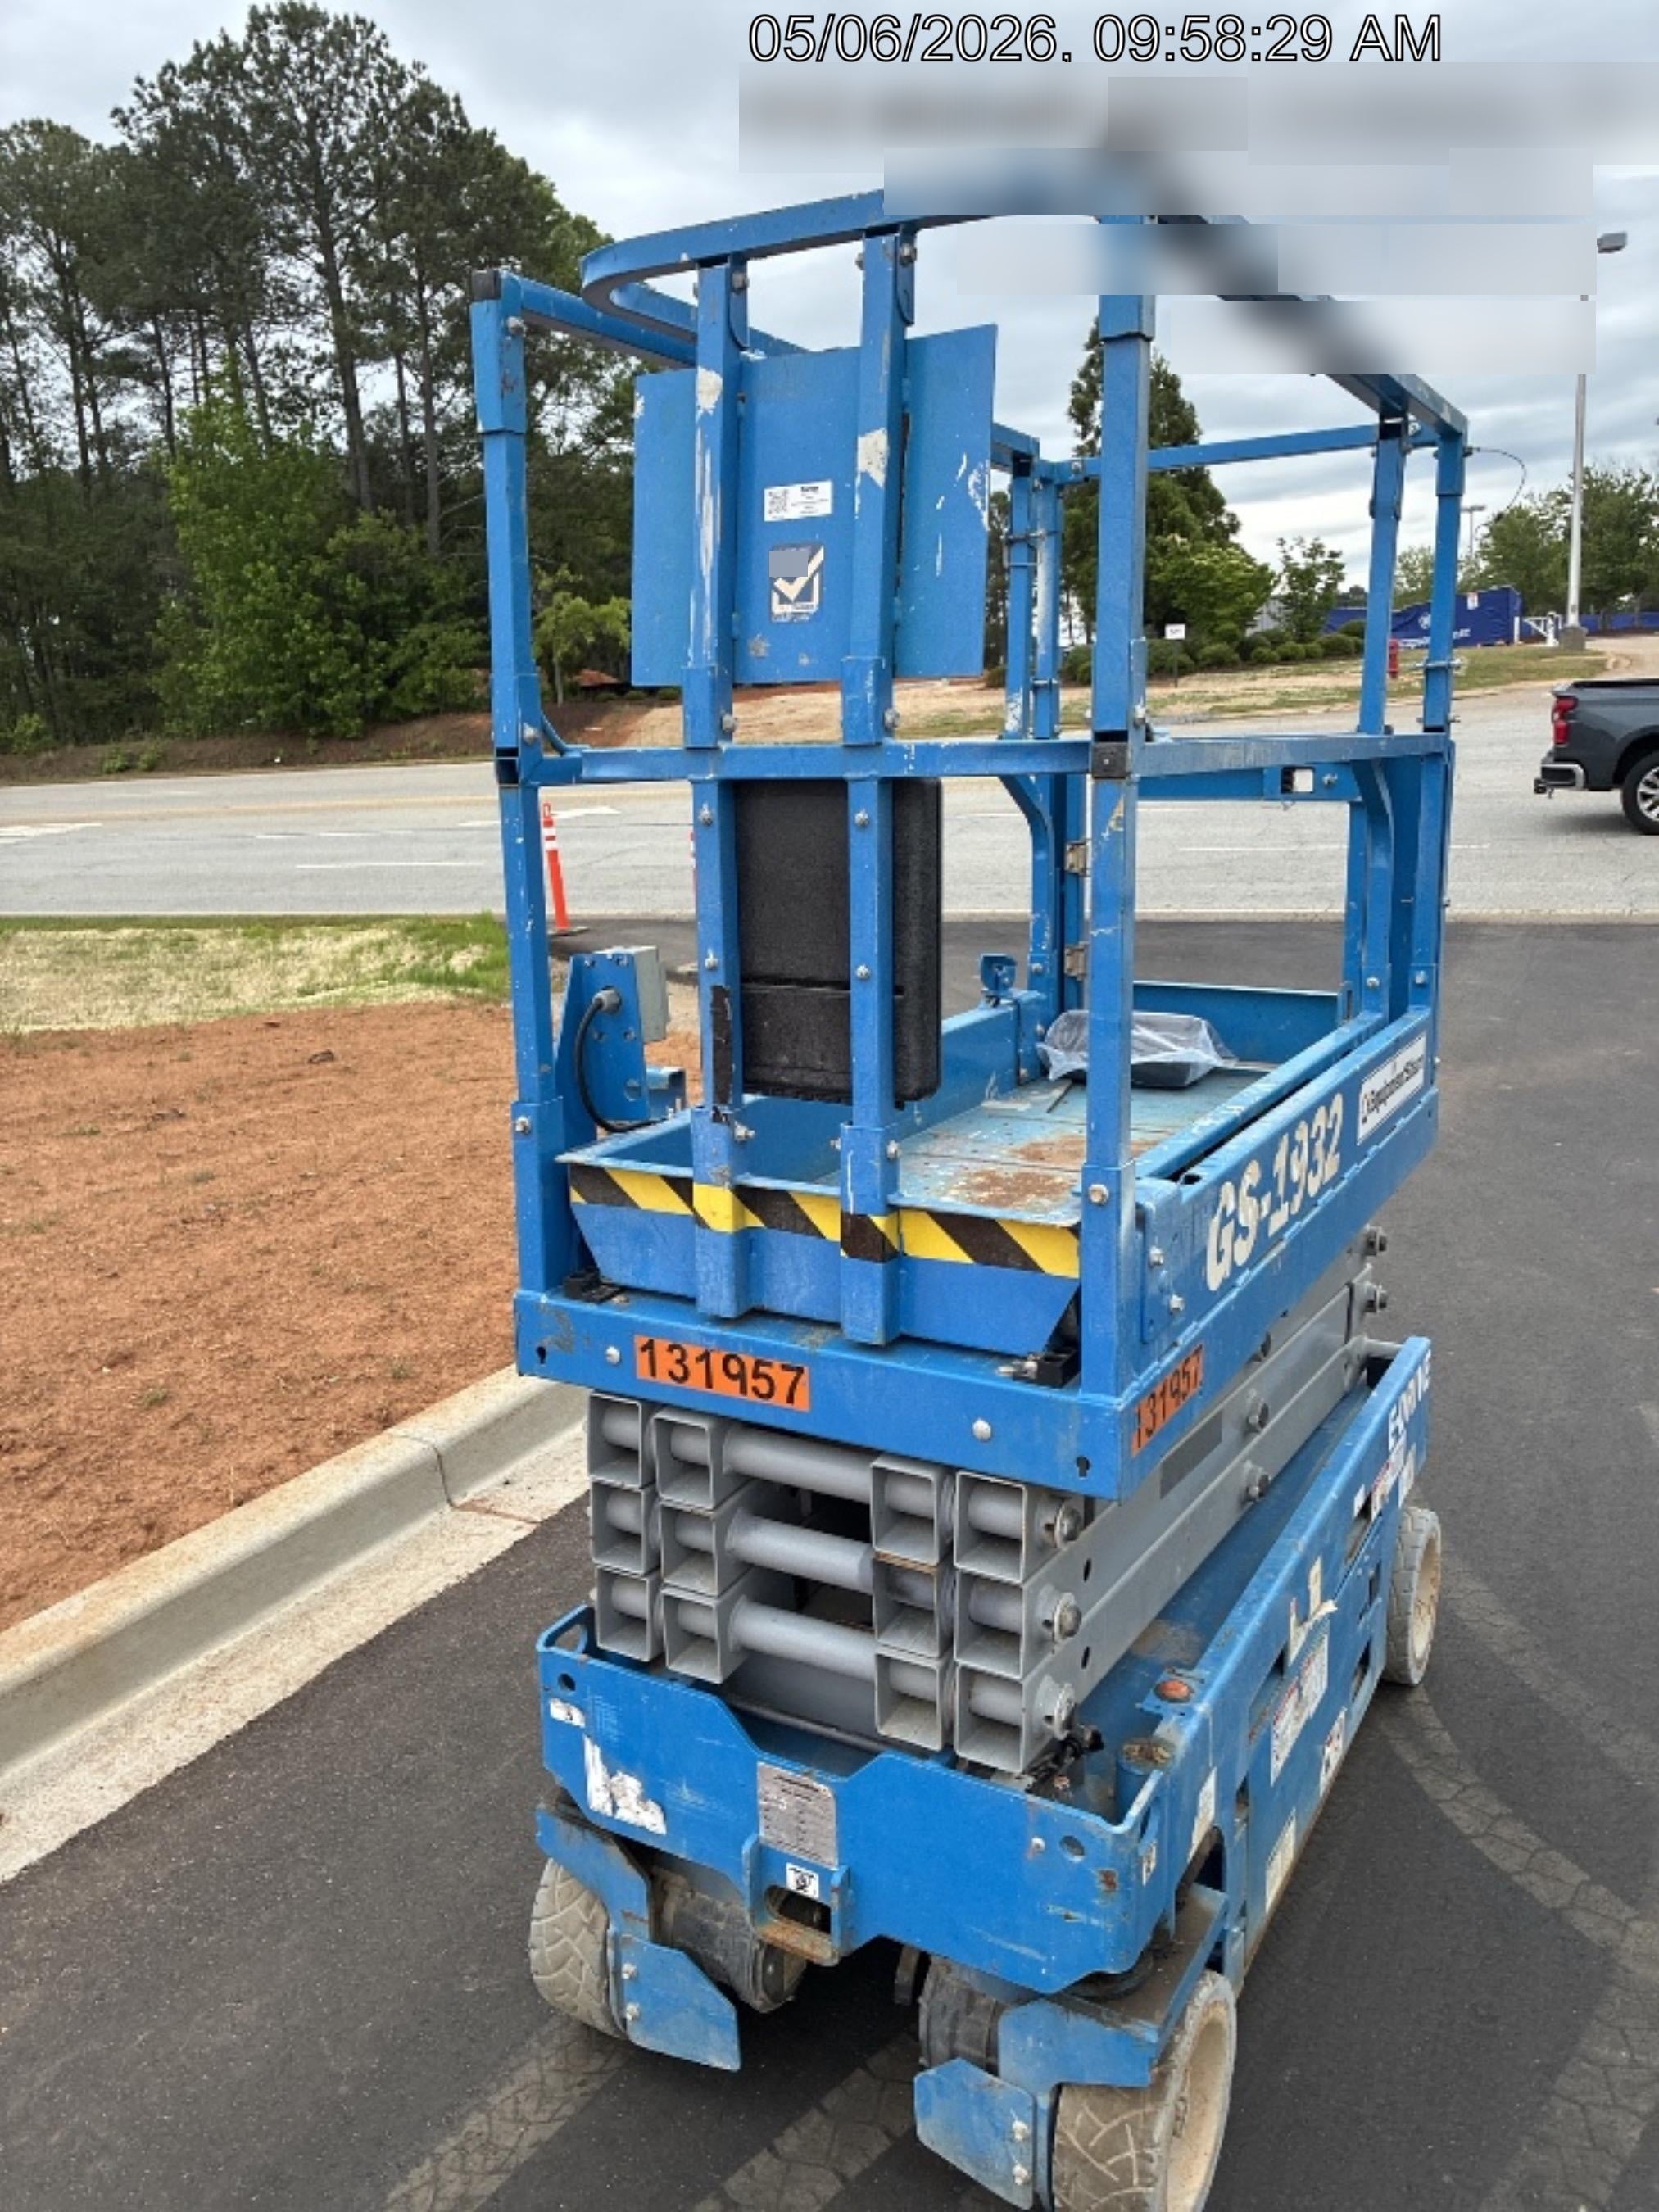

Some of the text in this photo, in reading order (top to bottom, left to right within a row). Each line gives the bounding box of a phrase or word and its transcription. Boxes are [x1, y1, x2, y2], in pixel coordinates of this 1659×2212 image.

[1207, 1093, 1343, 1291] GS-1932
[640, 1339, 805, 1405] 131957
[1137, 1344, 1203, 1448] 131957
